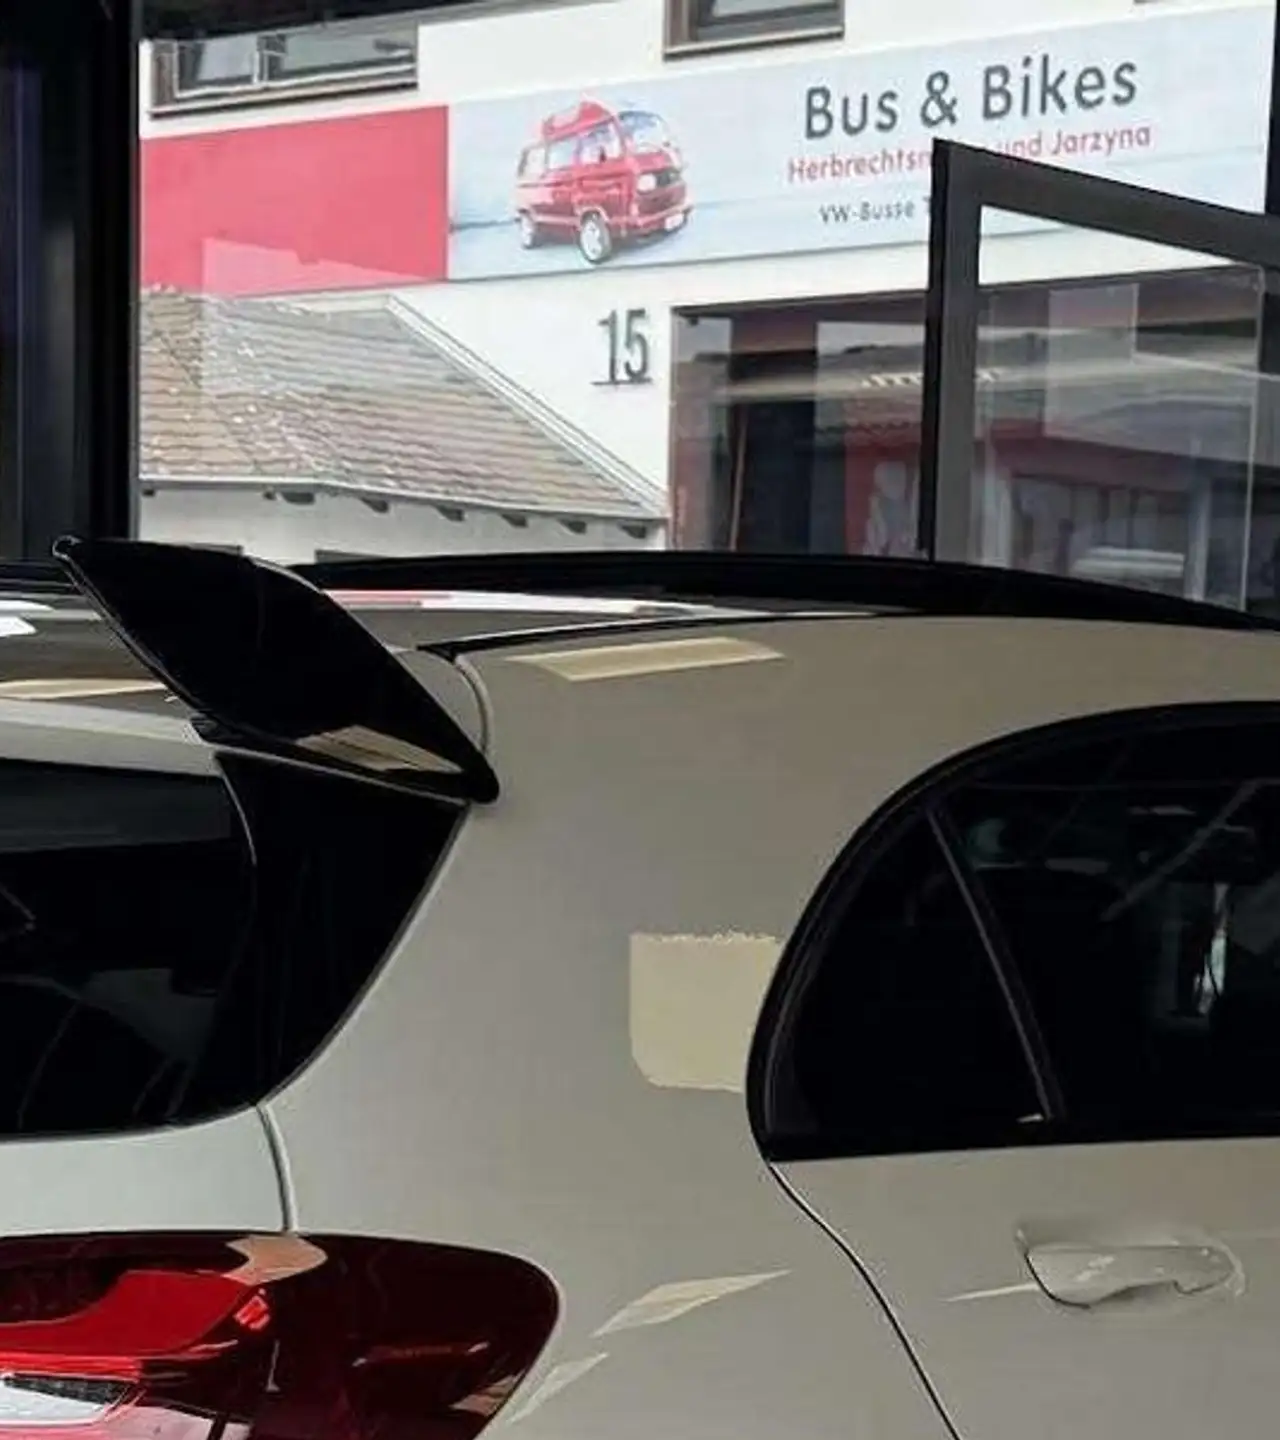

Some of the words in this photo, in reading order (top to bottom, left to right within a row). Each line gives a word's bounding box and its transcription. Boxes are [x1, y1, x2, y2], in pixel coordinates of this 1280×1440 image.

[805, 85, 899, 140] Bus
[920, 71, 959, 129] &
[983, 54, 1138, 121] Bikes
[1052, 126, 1152, 156] Jarzyna
[598, 307, 648, 384] 15
